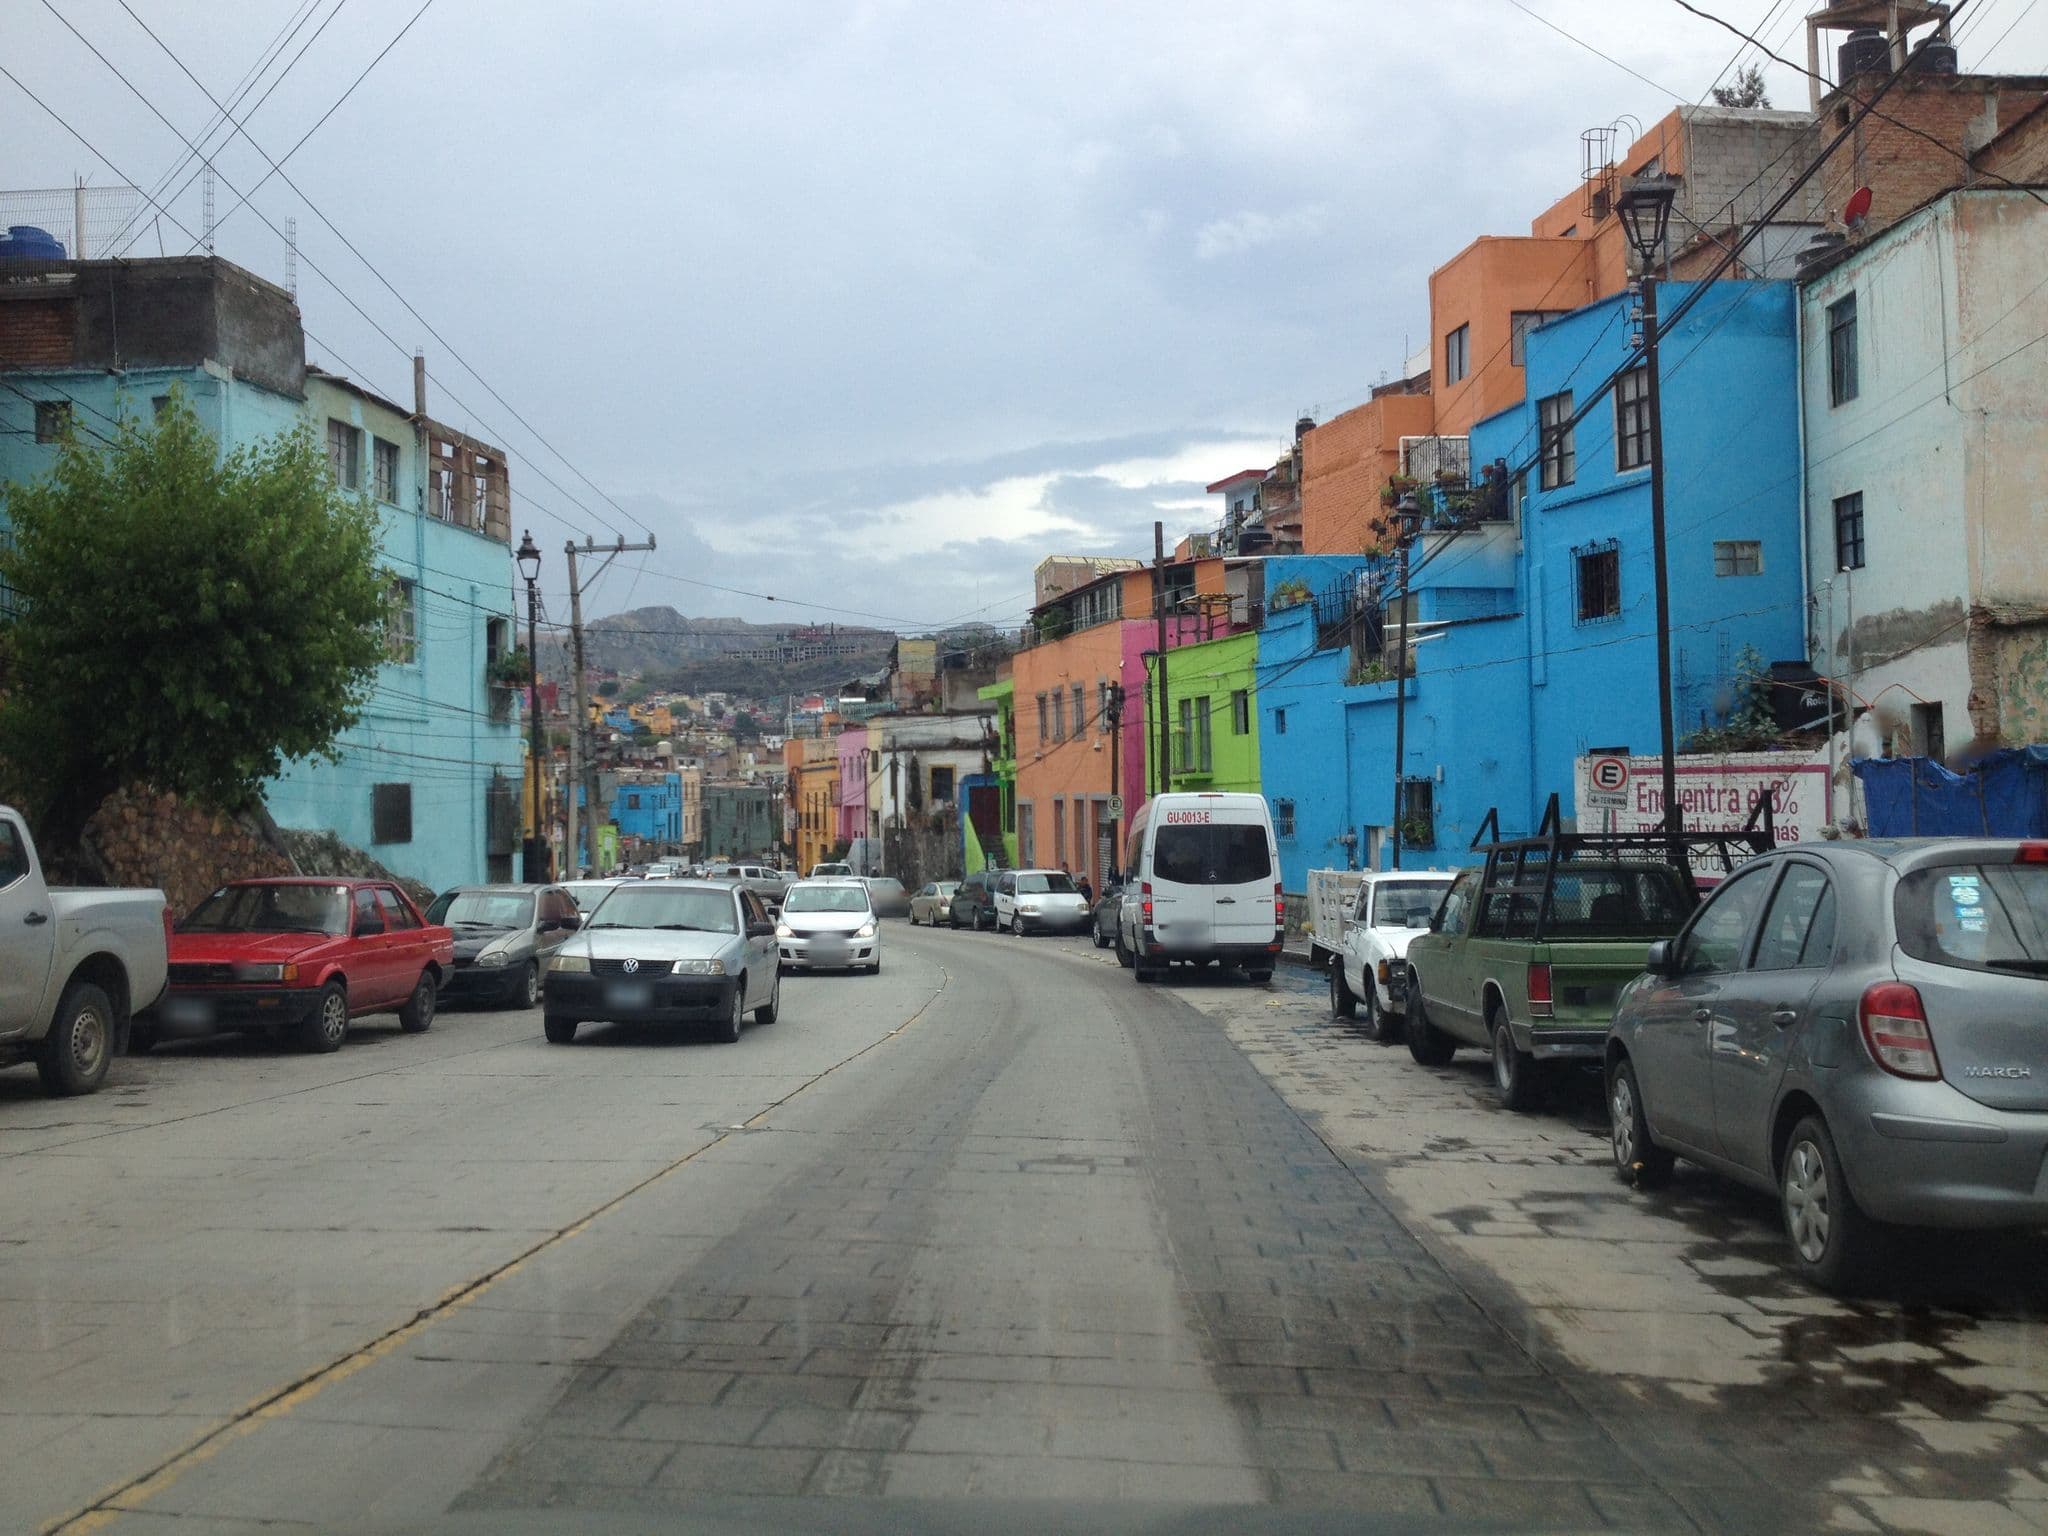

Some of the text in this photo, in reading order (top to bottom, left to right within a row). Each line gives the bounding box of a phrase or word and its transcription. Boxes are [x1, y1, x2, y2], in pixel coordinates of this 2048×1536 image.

[1602, 765, 1618, 783] E
[1167, 811, 1210, 823] GU-0013-E
[1964, 1066, 2031, 1078] MARCH
